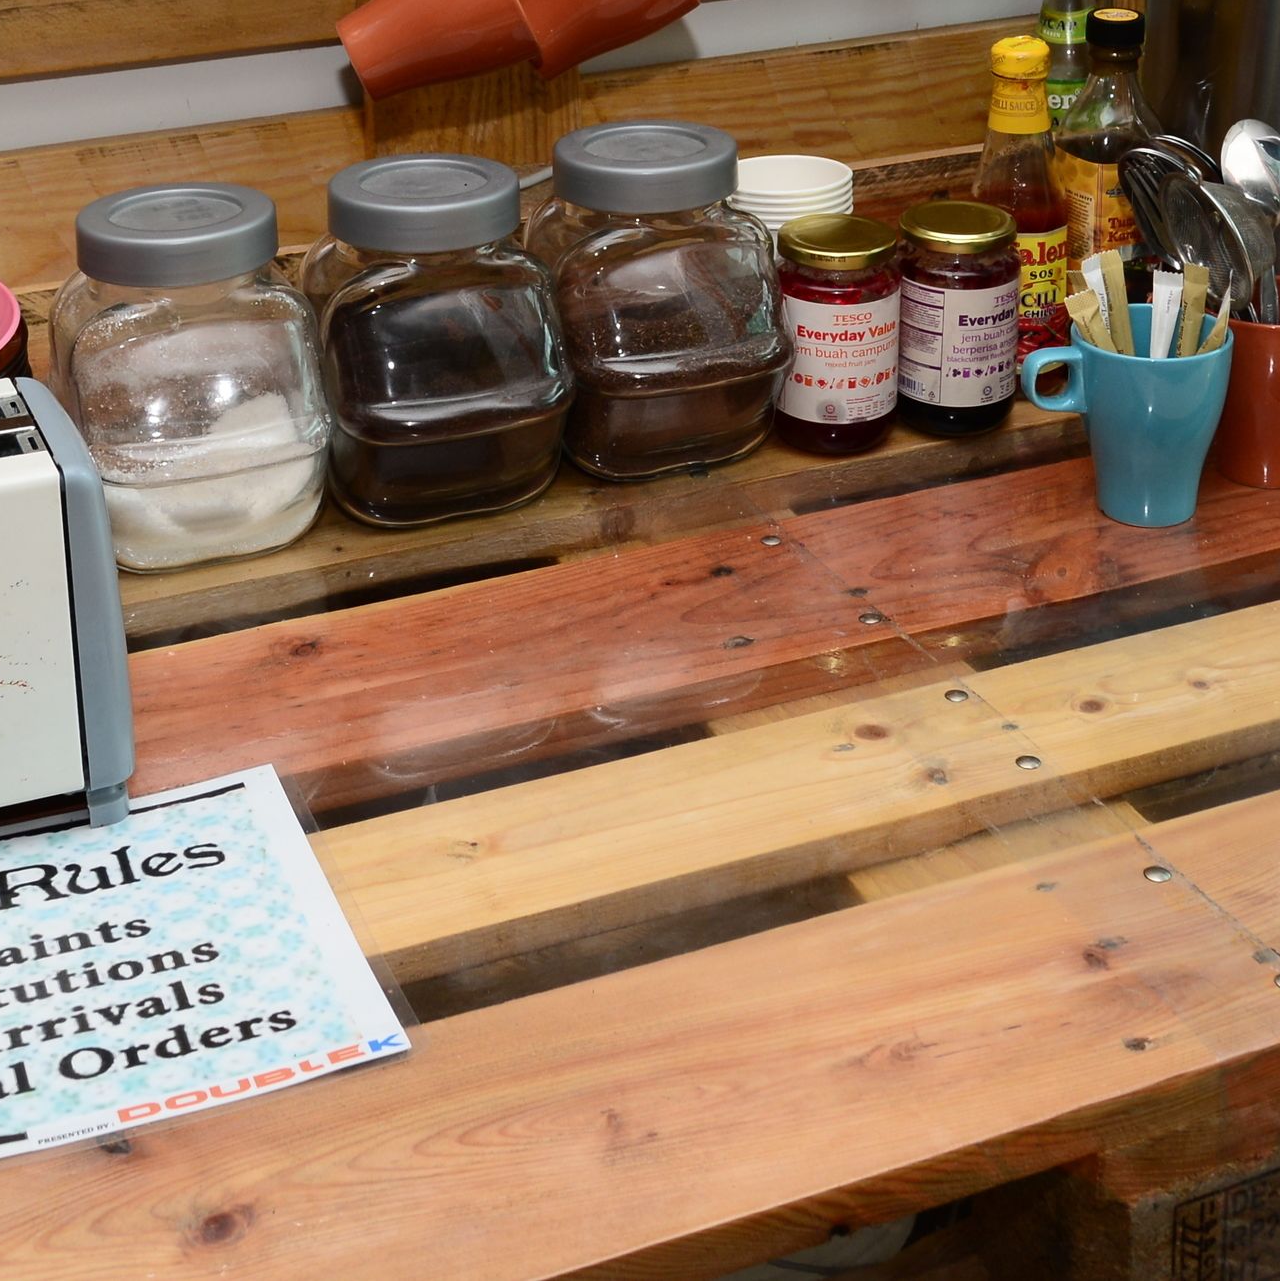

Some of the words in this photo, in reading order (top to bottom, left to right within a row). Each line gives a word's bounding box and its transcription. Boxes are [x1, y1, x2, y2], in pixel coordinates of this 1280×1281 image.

[1009, 100, 1036, 111] SAUCE
[1029, 268, 1054, 280] SOS
[833, 312, 873, 323] TESCO
[958, 306, 1015, 327] Everyday
[796, 324, 865, 344] Everyday
[961, 334, 982, 344] jem
[795, 346, 812, 357] em
[815, 345, 848, 359] buah
[57, 1006, 298, 1082] Orders
[36, 1127, 96, 1146] PRESENTED
